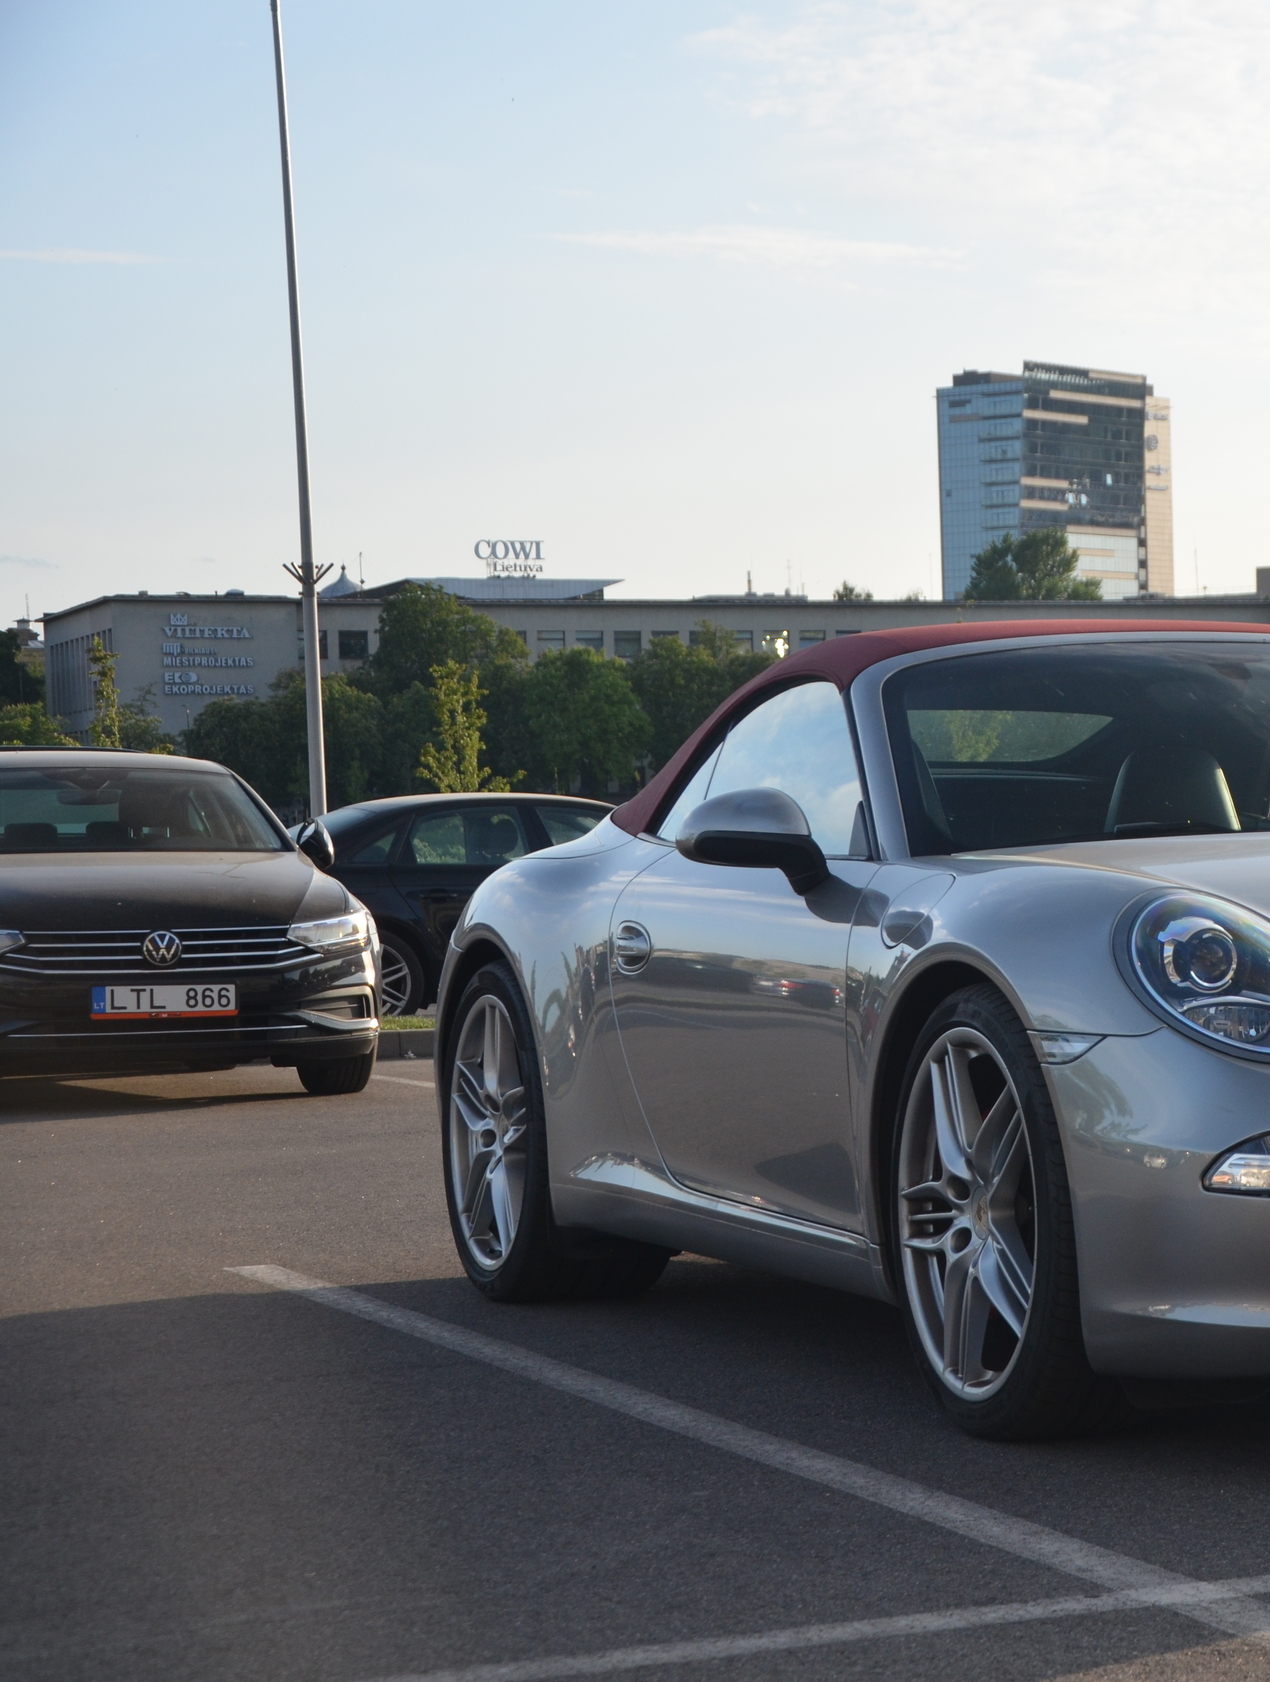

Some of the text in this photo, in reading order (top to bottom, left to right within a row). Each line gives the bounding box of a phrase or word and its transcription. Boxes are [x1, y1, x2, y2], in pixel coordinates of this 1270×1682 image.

[474, 539, 545, 560] COWI
[493, 561, 543, 572] Lietuva
[163, 657, 254, 667] MIESTPROJEKTAS
[164, 685, 255, 694] EKOPROJEKTAS
[110, 987, 231, 1010] LTL 866
